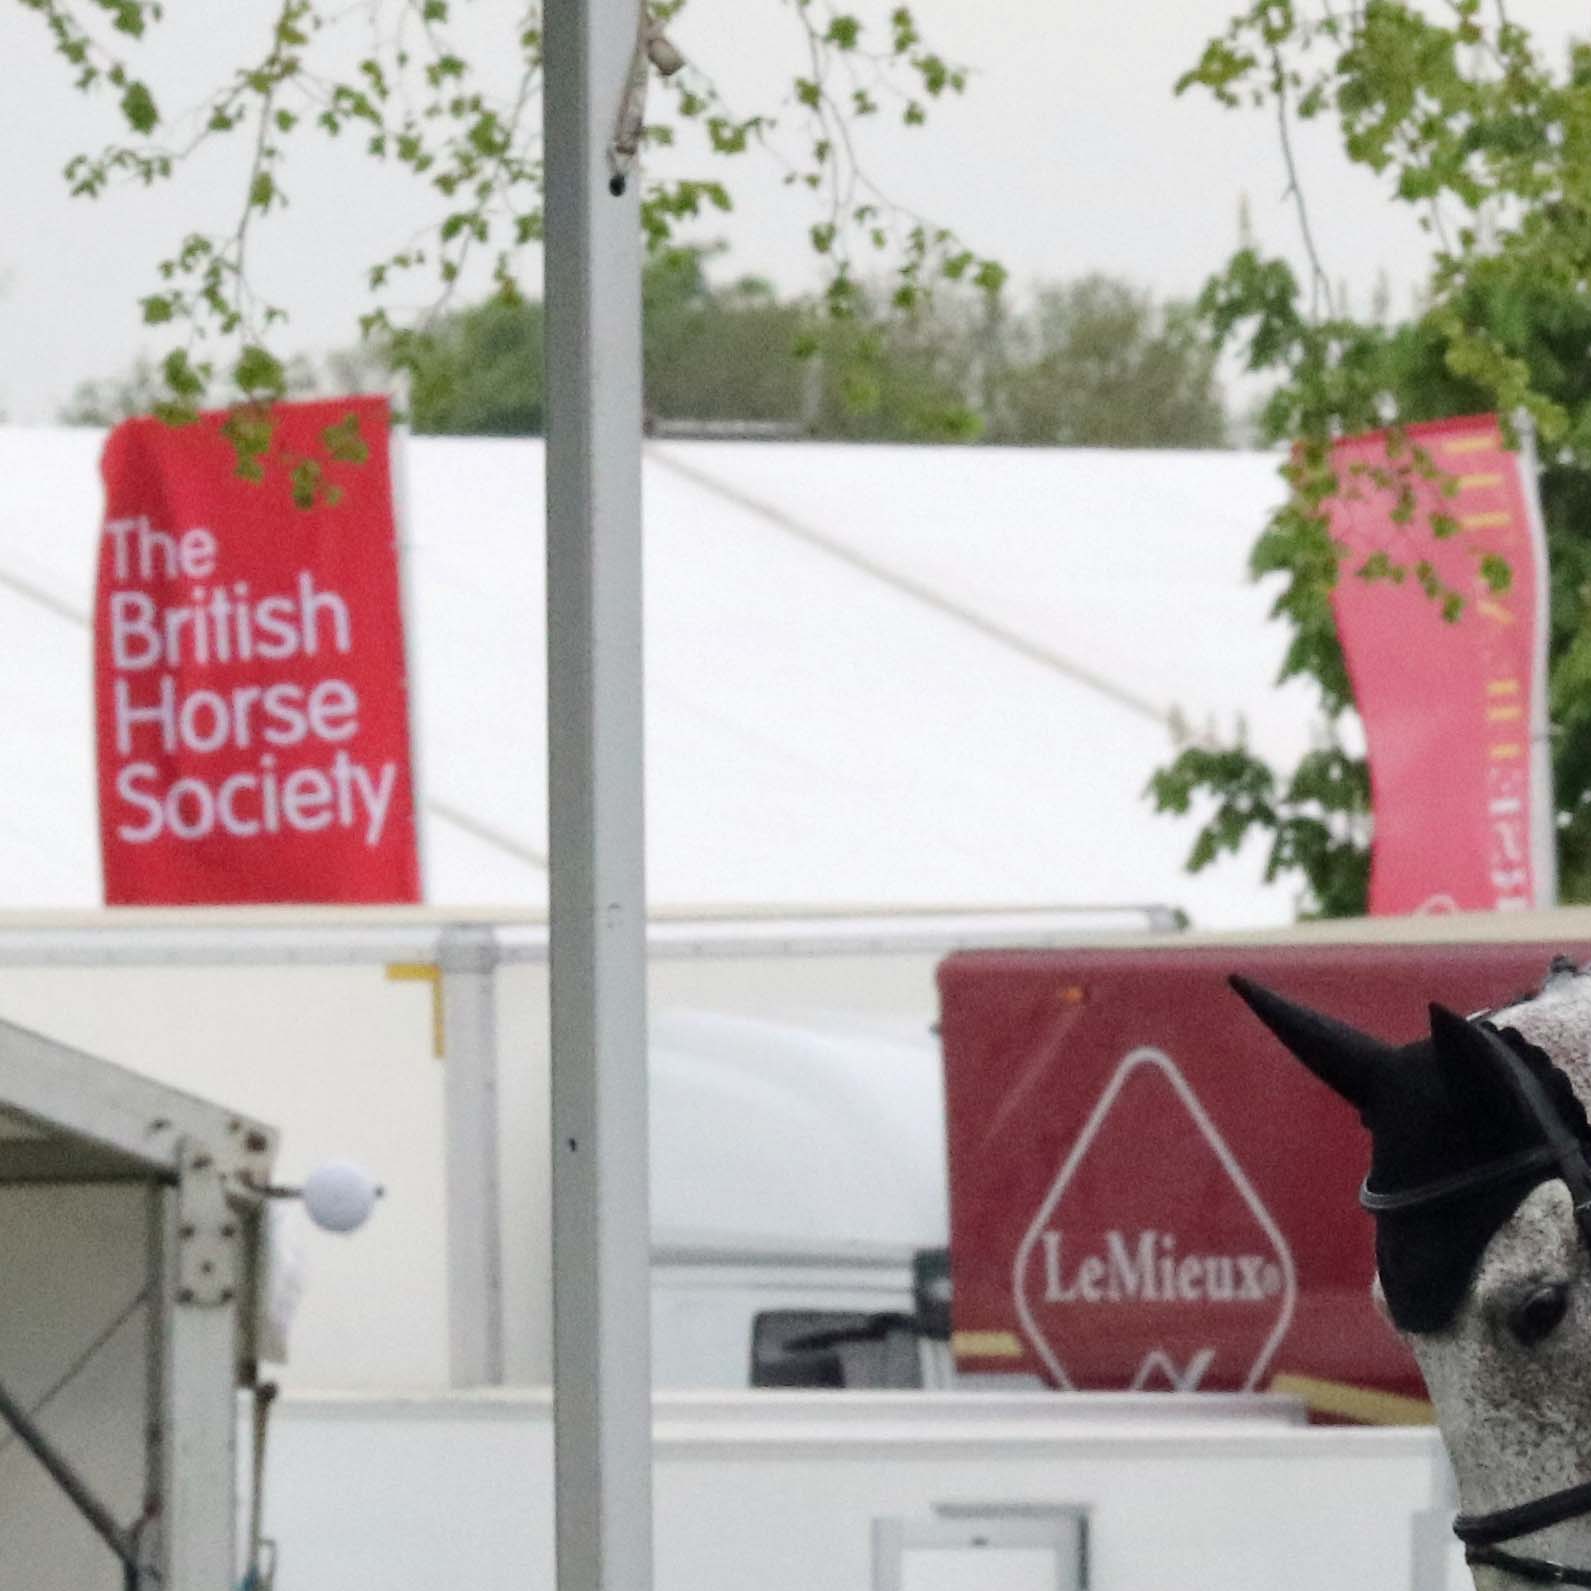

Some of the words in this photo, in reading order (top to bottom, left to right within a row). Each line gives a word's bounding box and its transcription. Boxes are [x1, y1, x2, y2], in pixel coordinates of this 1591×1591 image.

[104, 516, 216, 580] The
[110, 572, 350, 672] British
[113, 678, 359, 757] Horse
[117, 750, 398, 847] Society
[1042, 1229, 1266, 1304] LeMieux
